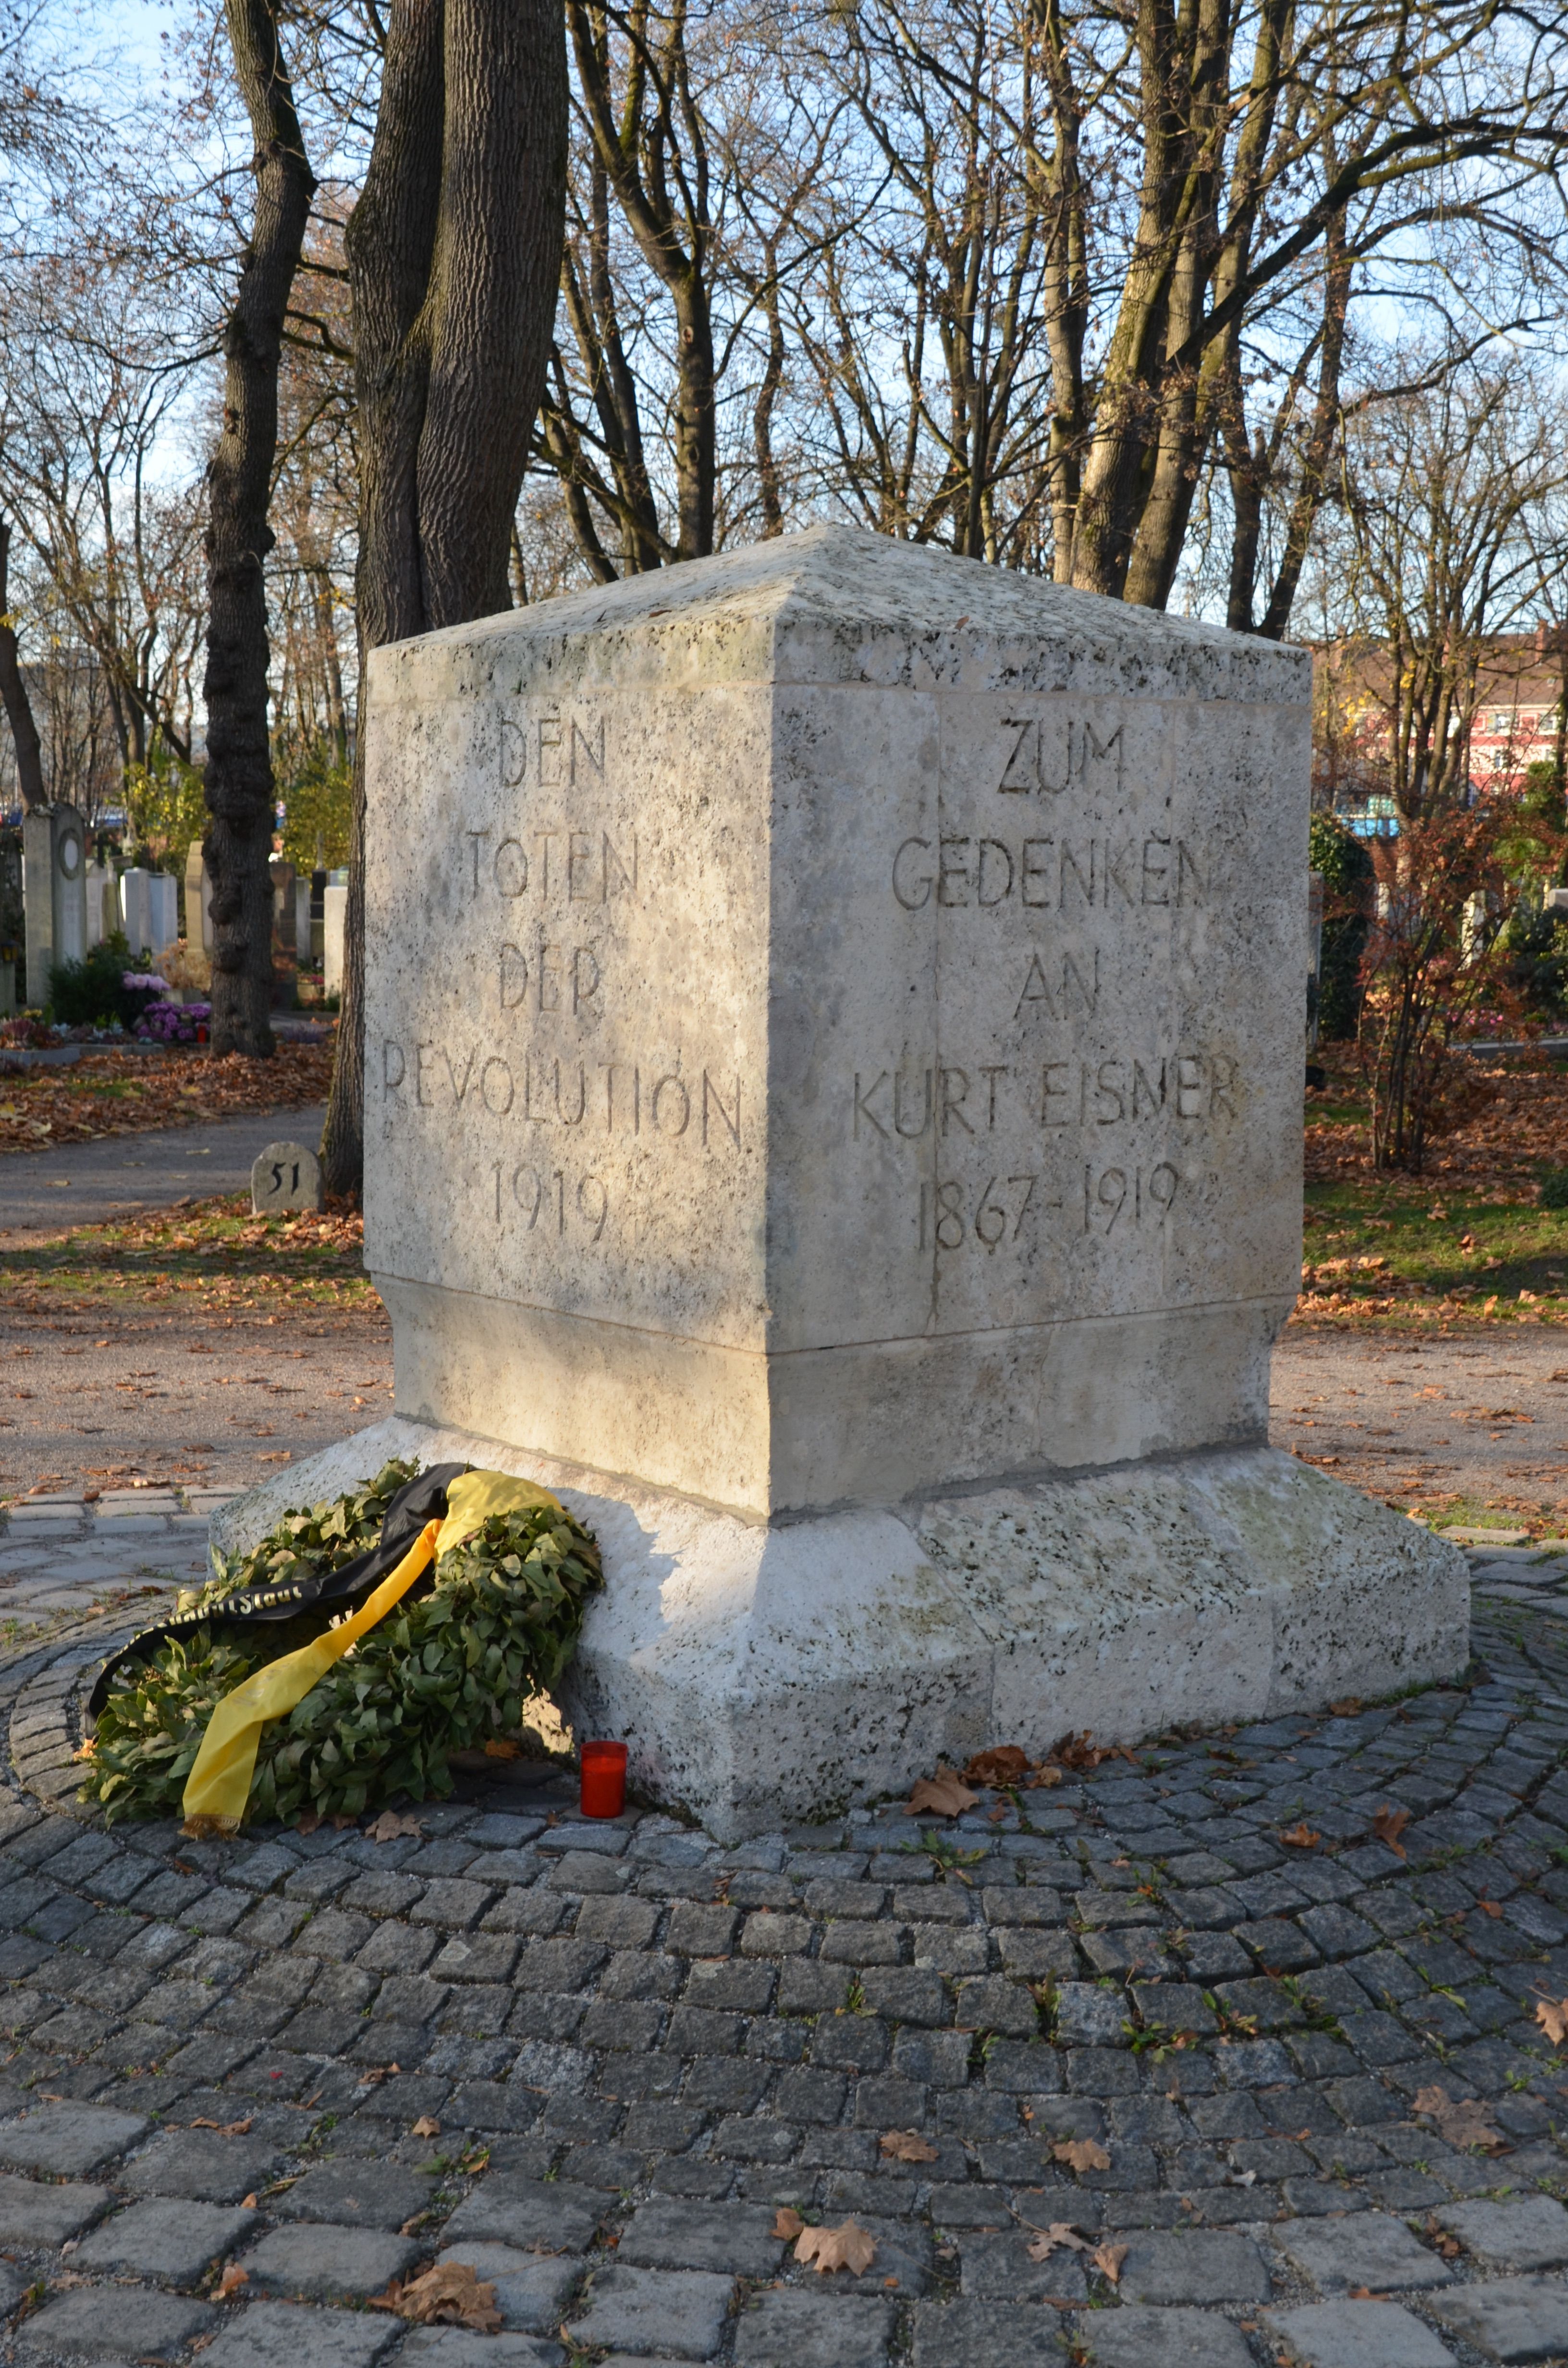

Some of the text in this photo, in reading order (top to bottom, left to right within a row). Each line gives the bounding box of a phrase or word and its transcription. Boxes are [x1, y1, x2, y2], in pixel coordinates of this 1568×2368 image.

[499, 715, 605, 788] DEN
[997, 717, 1125, 795] ZUM
[466, 830, 638, 904] TOTEN
[892, 836, 1212, 911] GEDENKEN
[499, 943, 600, 1016] DER
[1013, 947, 1100, 1021] AN
[383, 1039, 741, 1154] REVOLUTION
[853, 1056, 1239, 1142] KURT EISNER
[267, 1161, 299, 1196] 51
[490, 1160, 608, 1242] 1919
